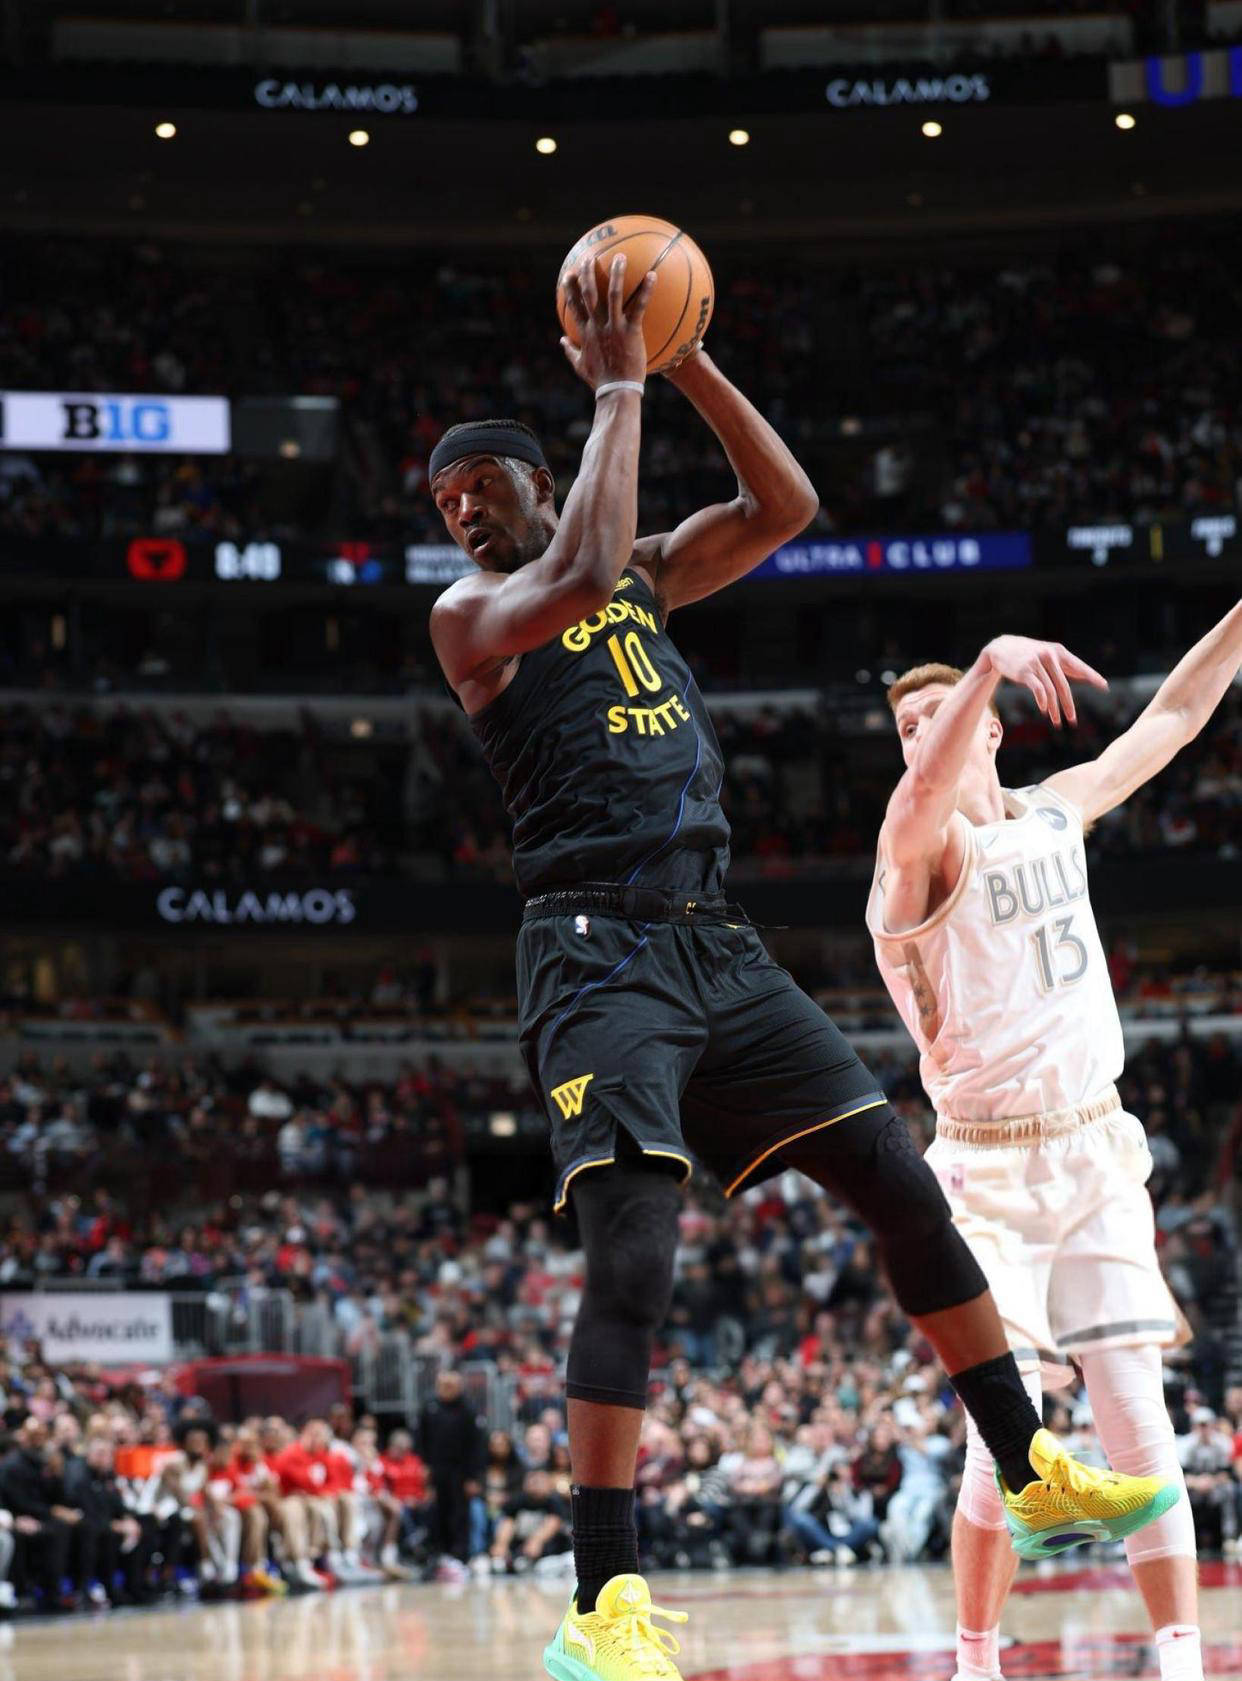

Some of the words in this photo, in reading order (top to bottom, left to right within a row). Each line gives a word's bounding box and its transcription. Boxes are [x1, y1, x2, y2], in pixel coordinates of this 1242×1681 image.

[255, 79, 418, 113] CALAMOS
[826, 74, 989, 107] CALAMOS
[774, 545, 862, 573] ULTRA
[886, 538, 981, 569] CLUB
[607, 631, 662, 697] 10
[607, 694, 691, 736] STATE
[157, 886, 355, 924] CALAMOS
[984, 846, 1088, 927] BULLS
[1026, 914, 1089, 998] 13
